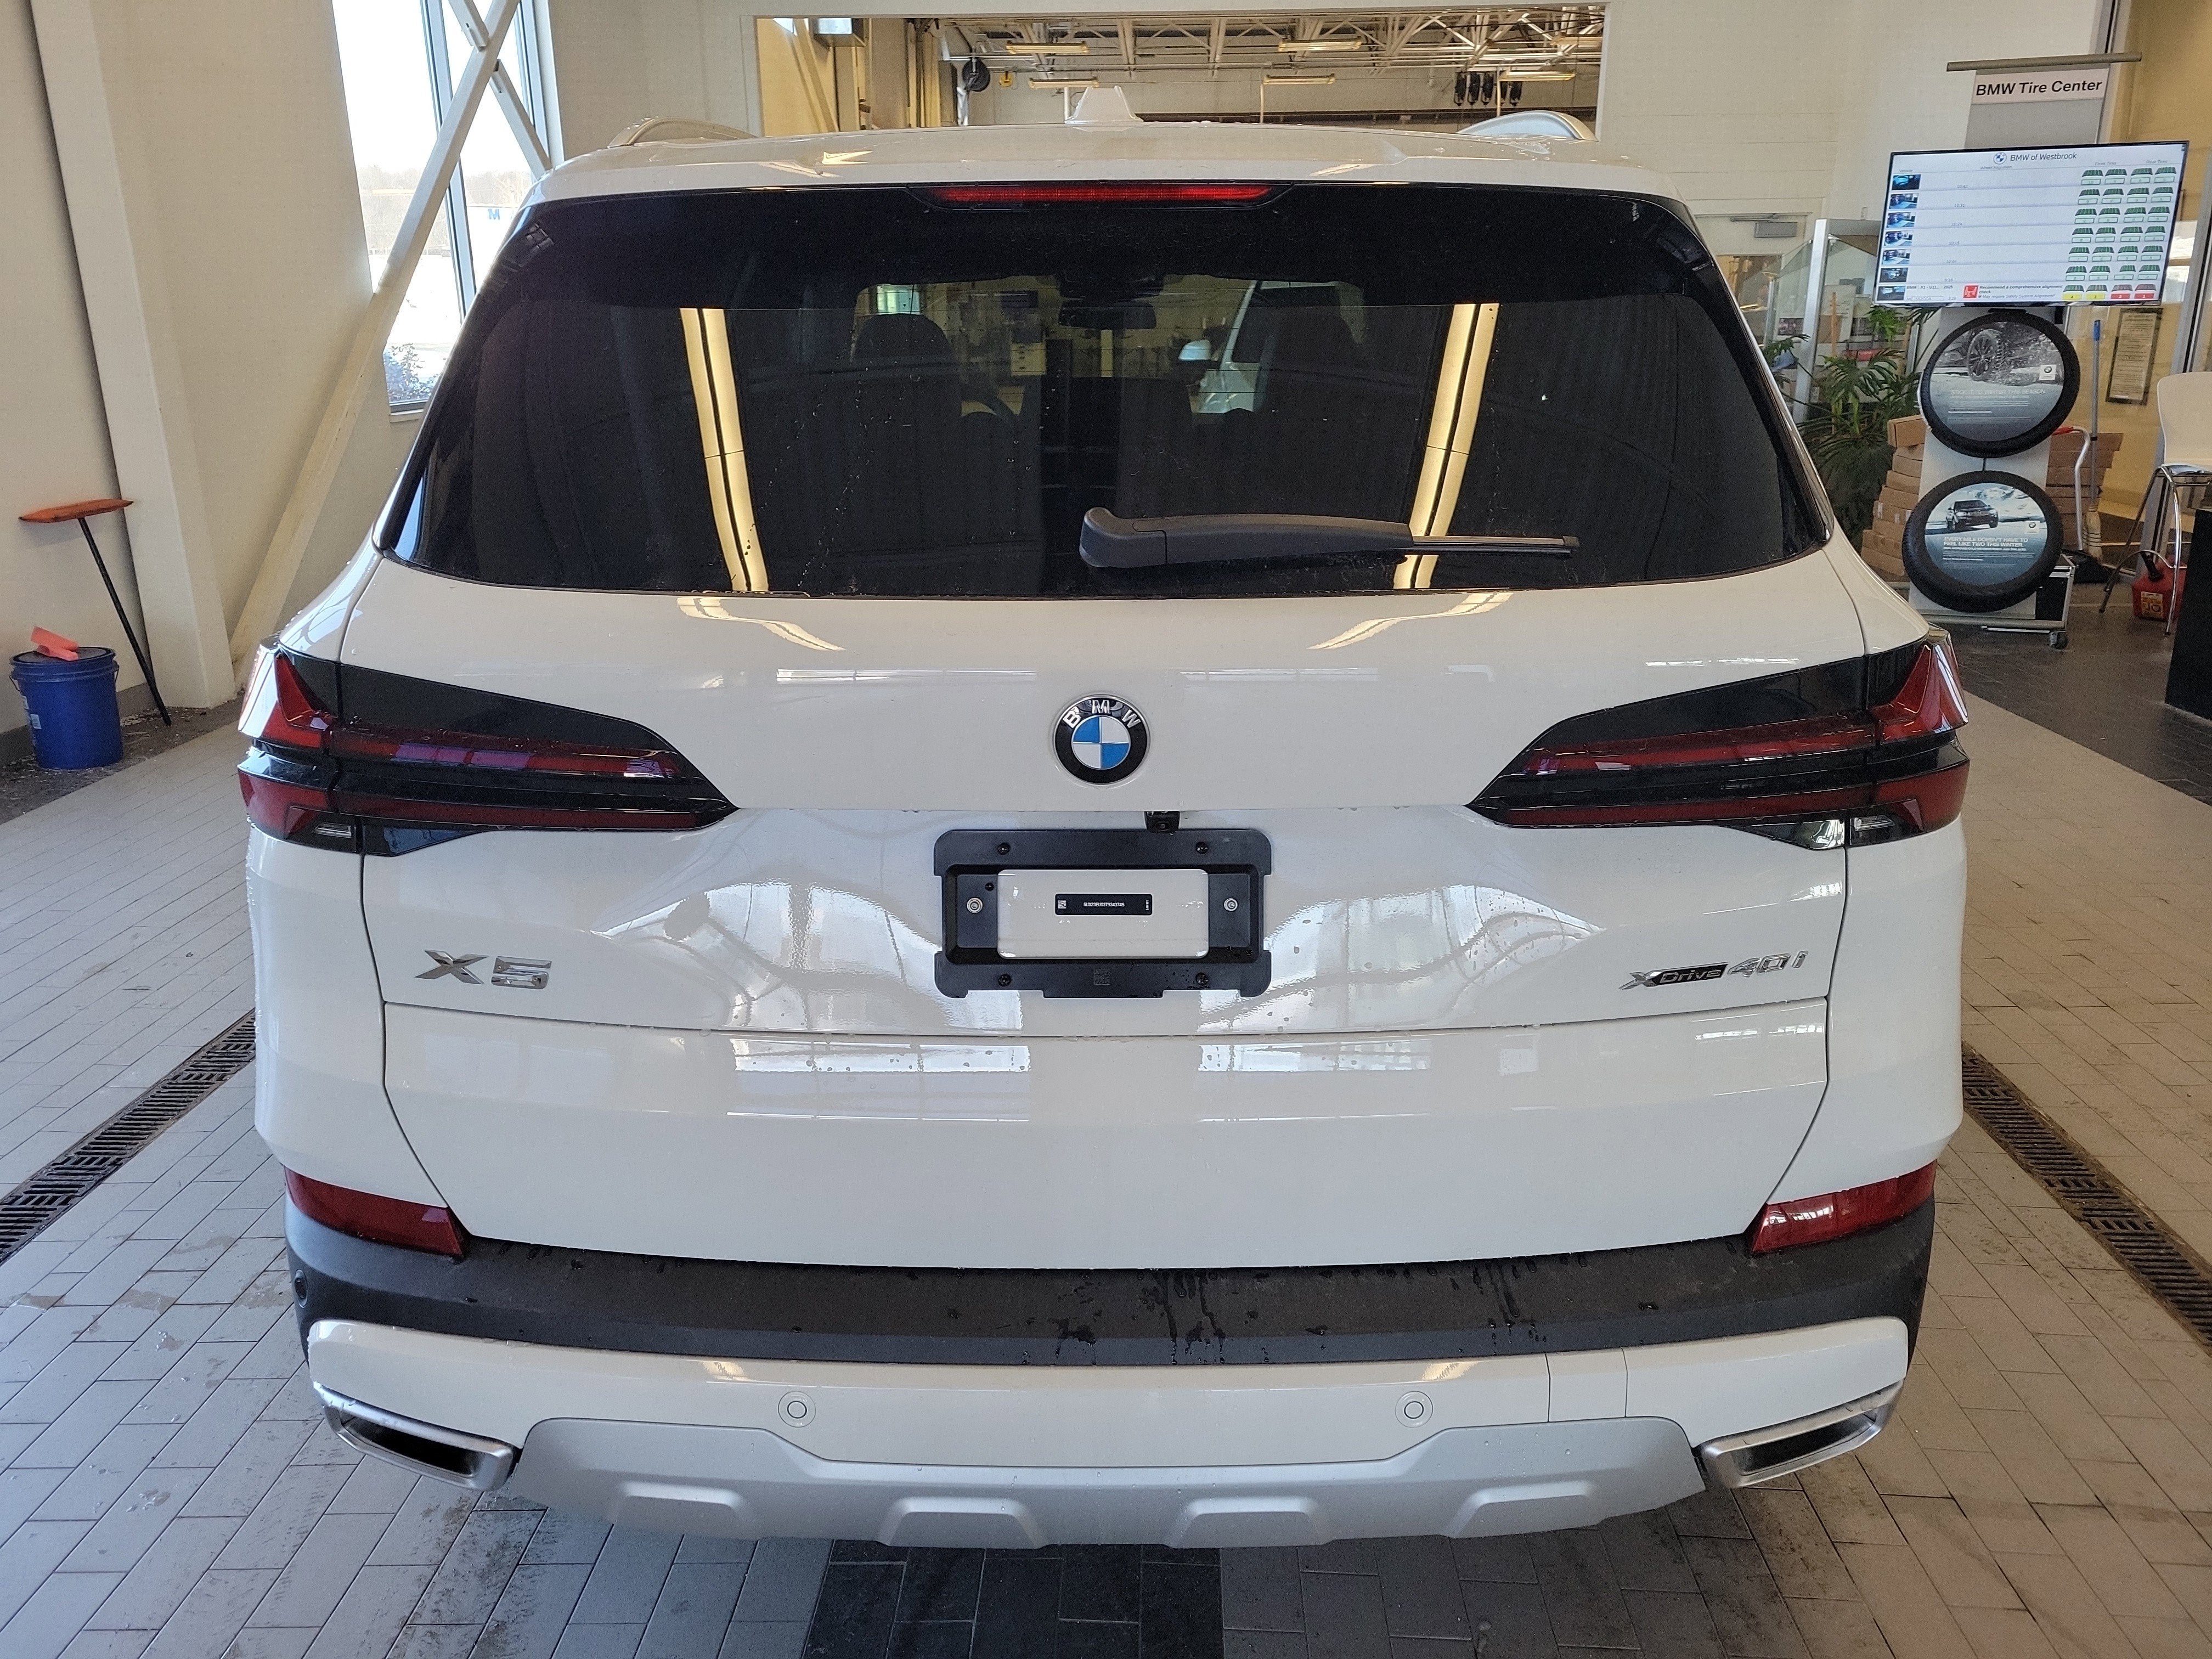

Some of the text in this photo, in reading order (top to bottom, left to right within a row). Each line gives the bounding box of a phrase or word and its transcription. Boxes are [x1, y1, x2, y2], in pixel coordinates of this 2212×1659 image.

[1976, 80, 2102, 95] BMW Tire Center
[1062, 699, 1142, 729] BMW
[414, 949, 552, 989] X5
